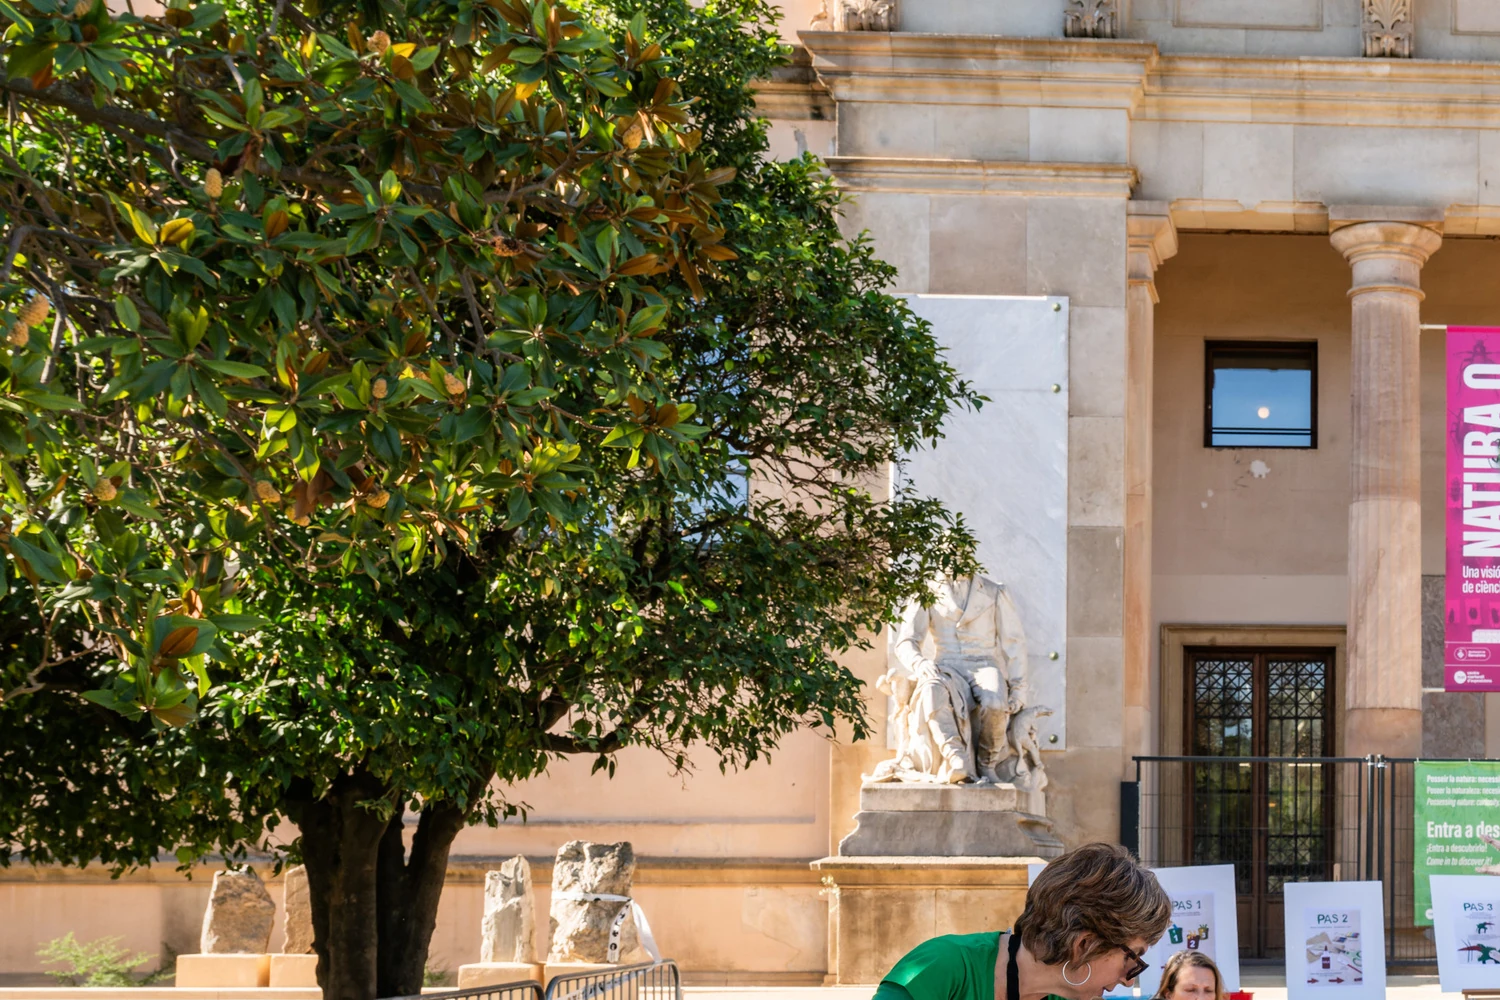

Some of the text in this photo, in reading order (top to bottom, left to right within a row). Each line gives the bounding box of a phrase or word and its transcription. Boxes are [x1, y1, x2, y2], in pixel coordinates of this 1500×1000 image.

[1462, 565, 1479, 579] Una
[1481, 565, 1500, 579] visió
[1462, 581, 1474, 593] de
[1427, 821, 1462, 838] Entra
[1464, 824, 1473, 838] a
[1172, 900, 1201, 910] PAS 1
[1464, 902, 1493, 911] PAS 3
[1318, 914, 1348, 924] PAS 2
